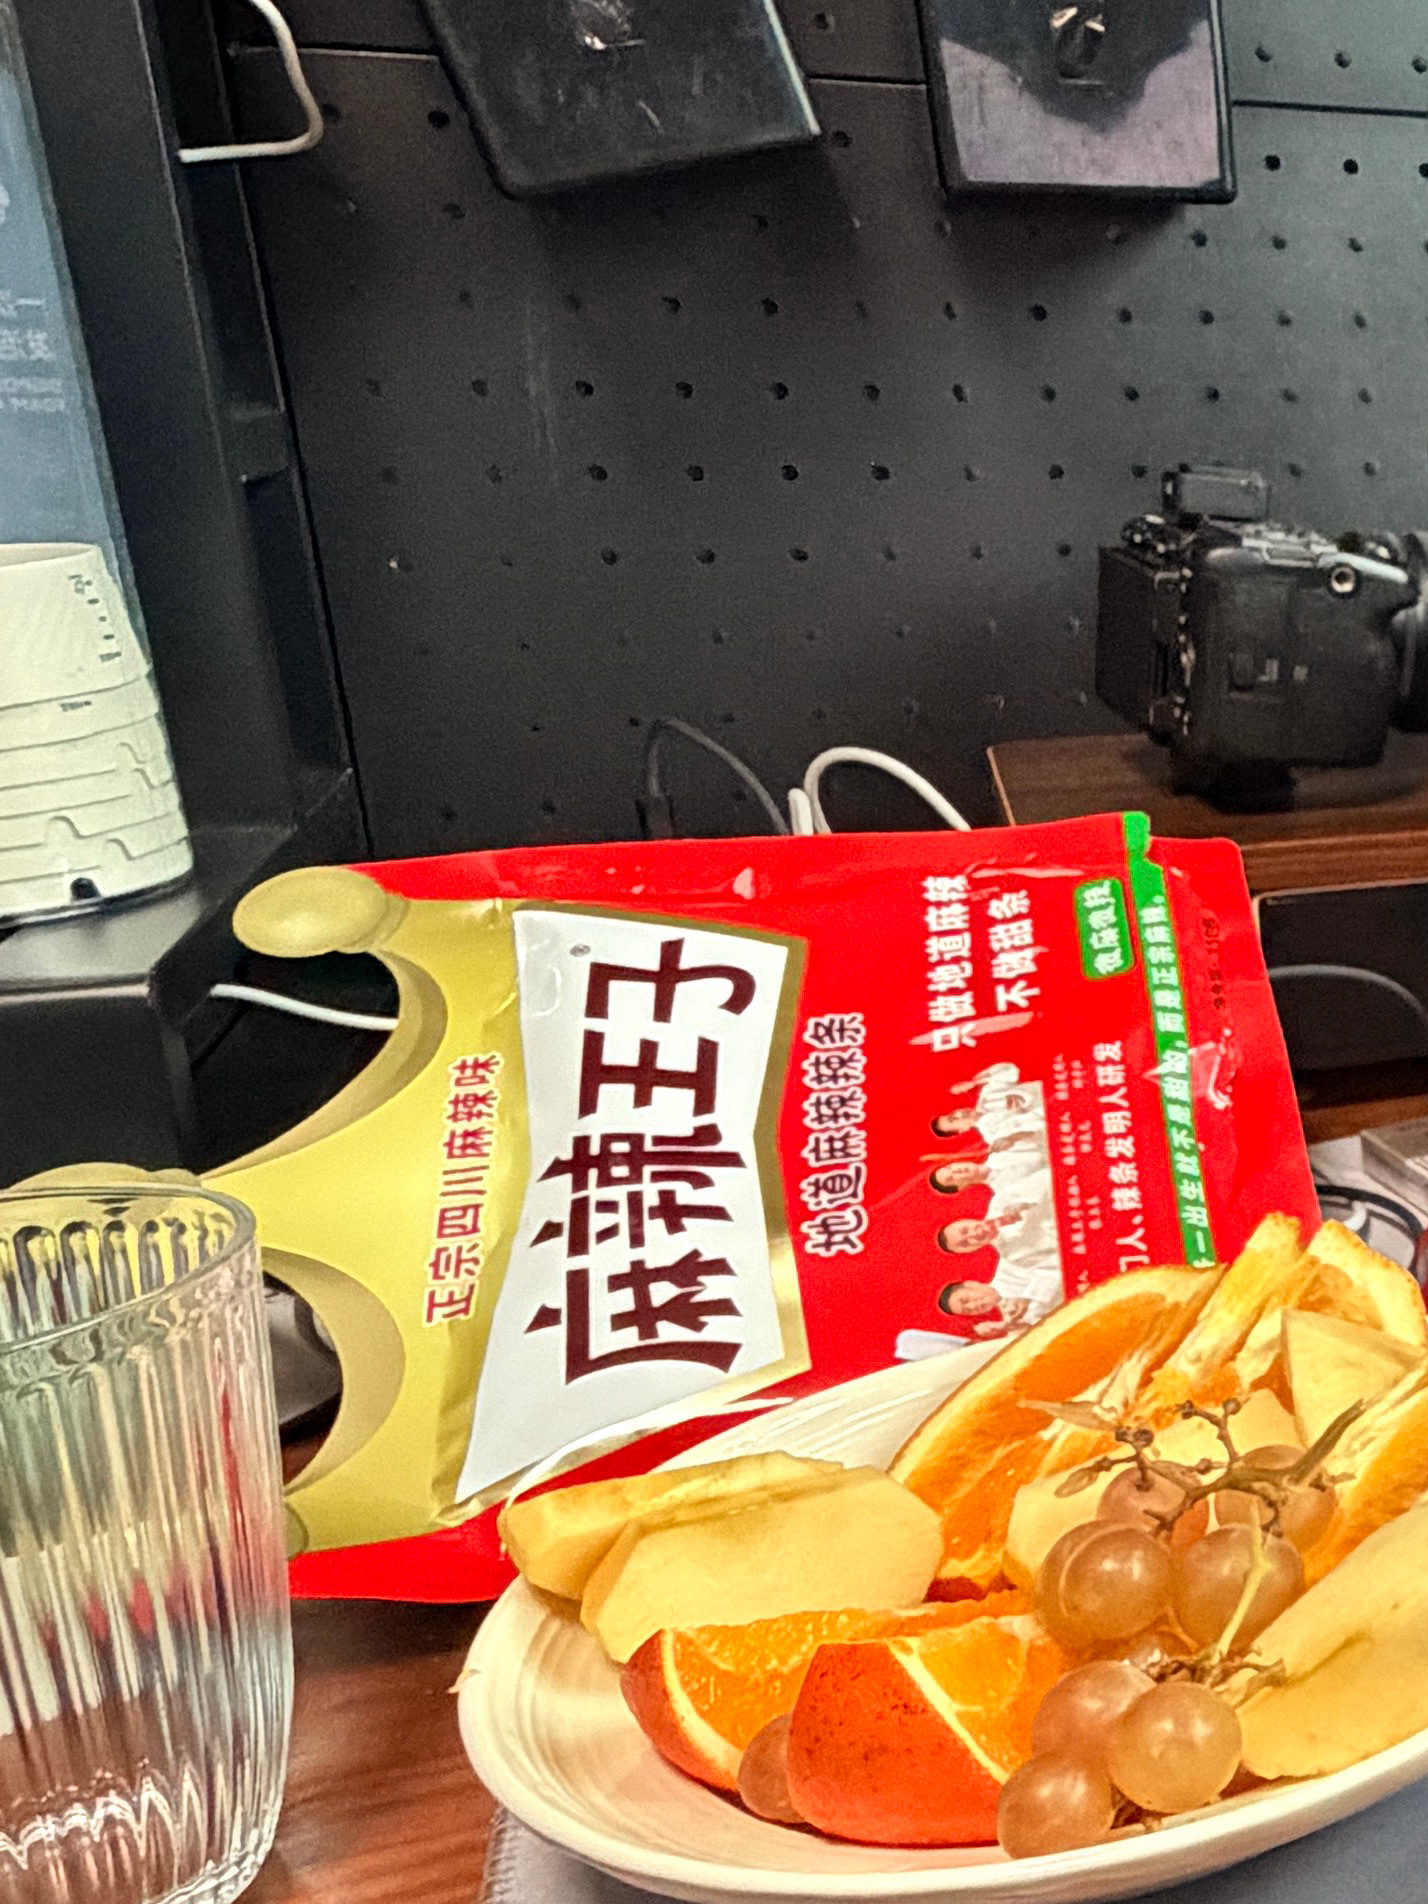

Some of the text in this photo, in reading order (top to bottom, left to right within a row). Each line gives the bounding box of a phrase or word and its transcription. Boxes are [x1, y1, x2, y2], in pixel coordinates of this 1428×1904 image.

[922, 874, 977, 1053] 只做地道麻辣
[987, 889, 1040, 1012] 不做甜条
[424, 1053, 501, 1325] 正宗四川麻辣味
[524, 937, 757, 1386] 麻辣王子
[804, 1012, 868, 1257] 地道麻辣辣条
